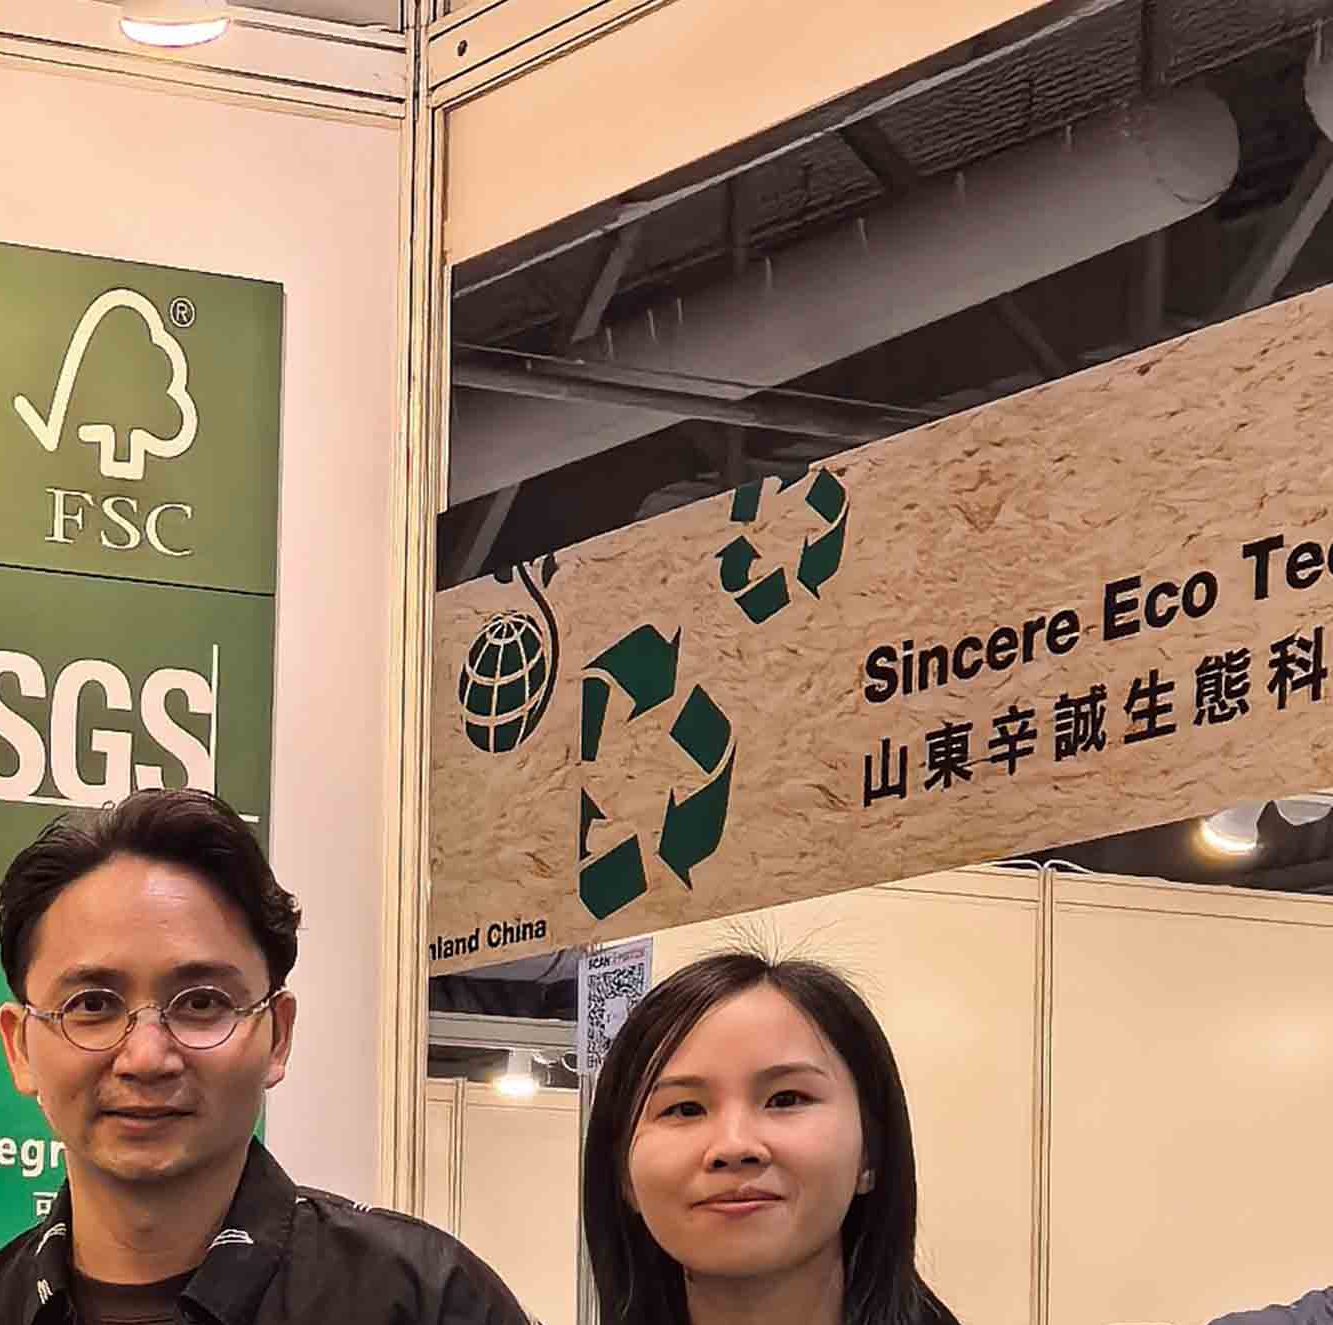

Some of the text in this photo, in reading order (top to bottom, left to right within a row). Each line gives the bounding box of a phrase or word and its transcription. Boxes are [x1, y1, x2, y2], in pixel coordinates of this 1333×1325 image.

[44, 487, 194, 557] FSC
[864, 533, 1333, 704] Sincere Eco Te
[863, 626, 1329, 807] 山東辛誠生態科
[429, 918, 547, 960] nland China
